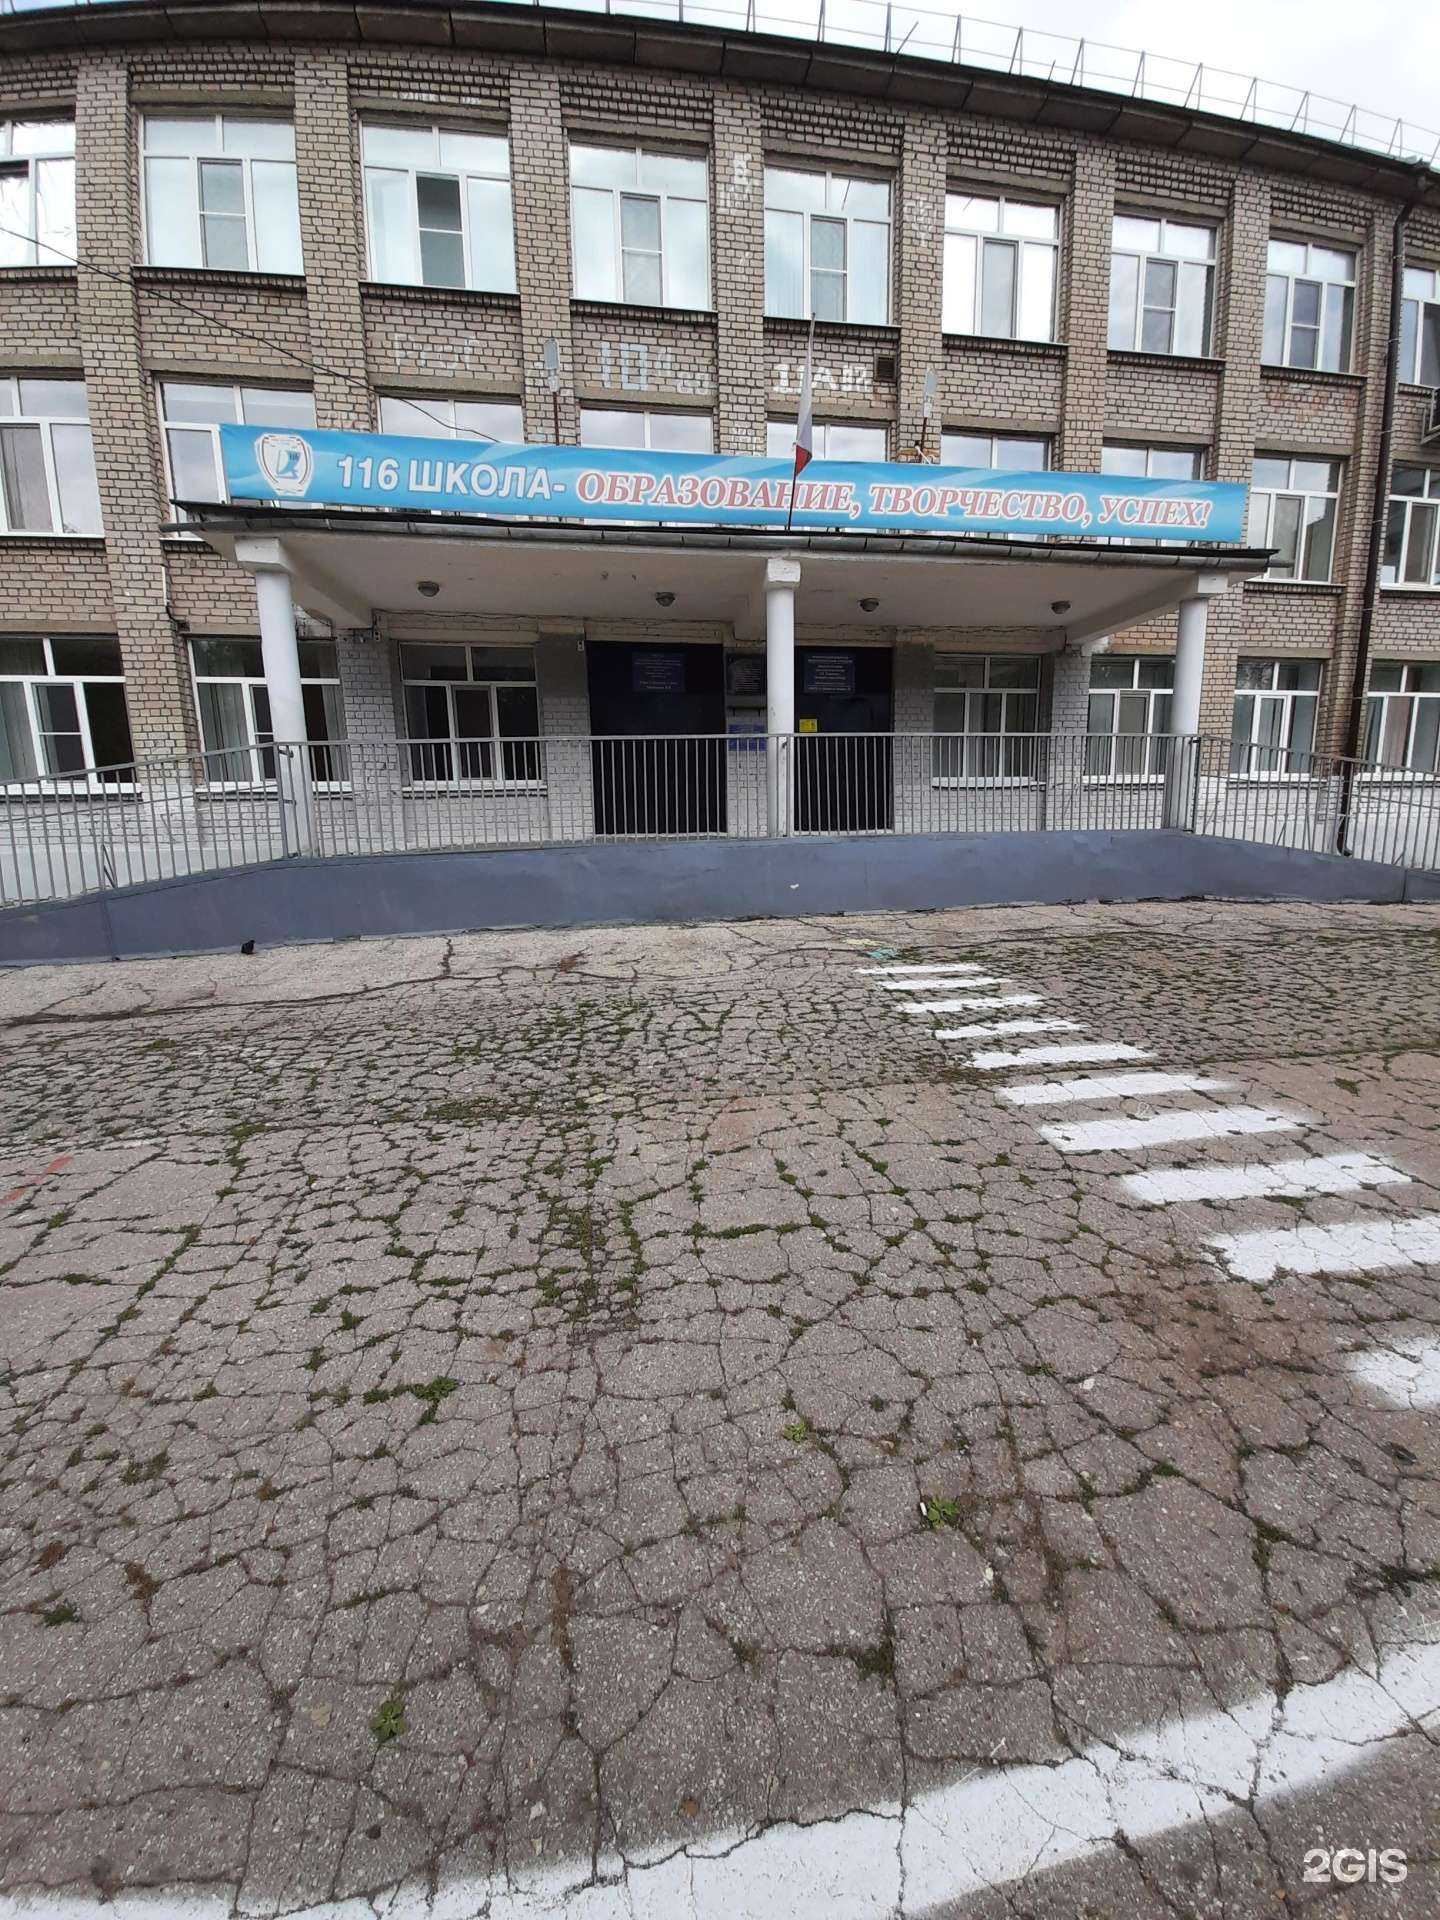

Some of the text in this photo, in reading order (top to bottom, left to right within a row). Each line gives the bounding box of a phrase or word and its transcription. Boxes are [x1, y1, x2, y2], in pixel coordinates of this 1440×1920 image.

[337, 455, 1213, 528] 116 ШКОЛА- ОБРАЗОВАНИЕ, ТВОРЧЕСТВО, УСПЕХ!
